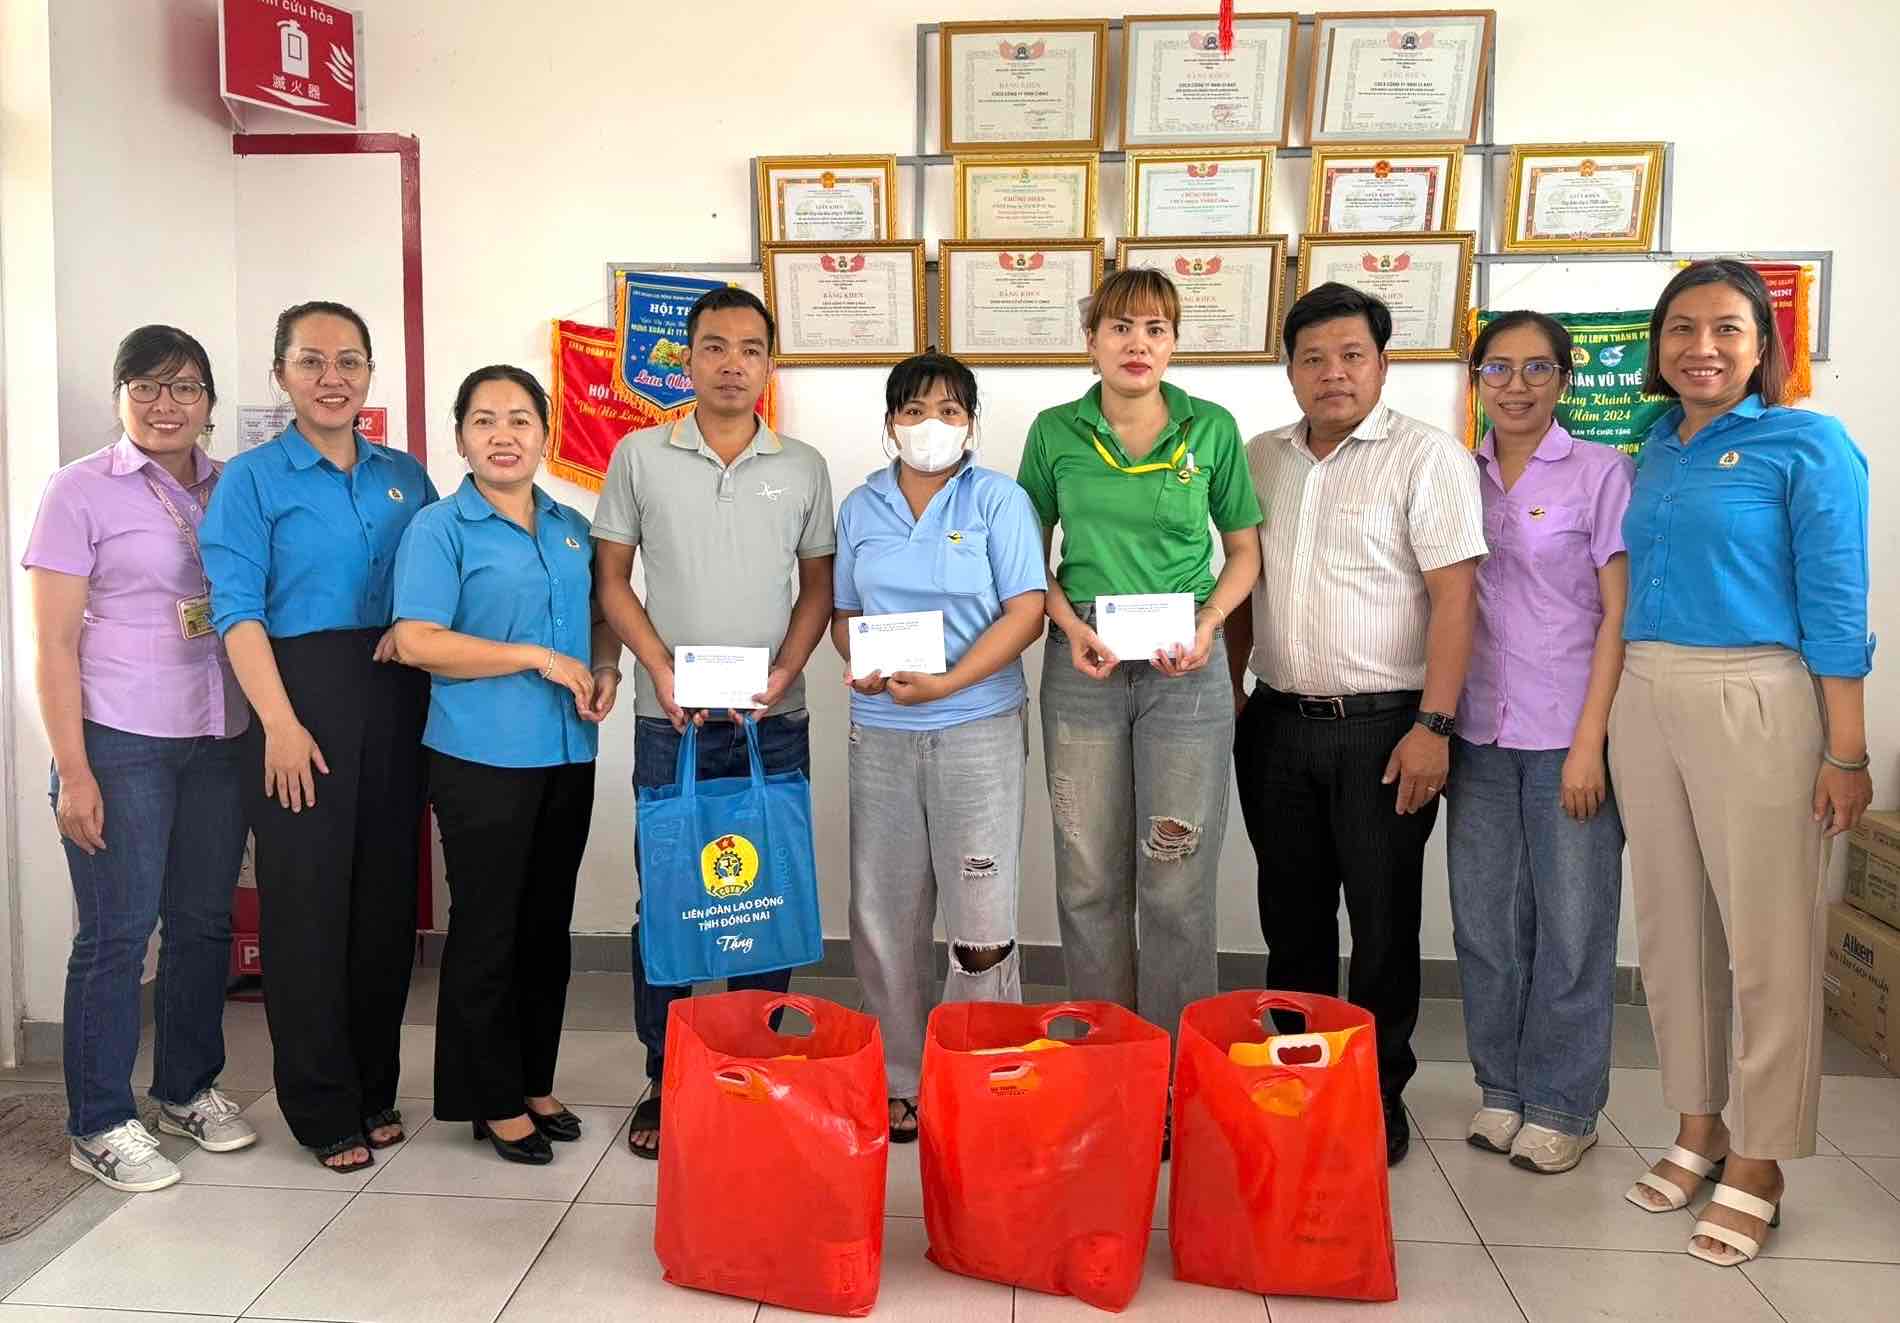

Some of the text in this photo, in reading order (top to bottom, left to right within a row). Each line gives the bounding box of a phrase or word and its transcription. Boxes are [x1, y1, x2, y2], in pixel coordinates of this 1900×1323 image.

[310, 5, 334, 25] hỏa
[649, 302, 692, 317] HỘI TH
[1597, 371, 1615, 387] VŨ
[1617, 367, 1643, 386] THỂ
[588, 383, 609, 400] HỘI
[1590, 391, 1631, 406] Khánh
[1568, 408, 1632, 422] Năm 2024
[1586, 426, 1595, 436] TỔ
[681, 907, 704, 920] LIÊN
[733, 900, 753, 912] LAO
[754, 895, 784, 910] ĐỘNG
[752, 910, 770, 924] NAI
